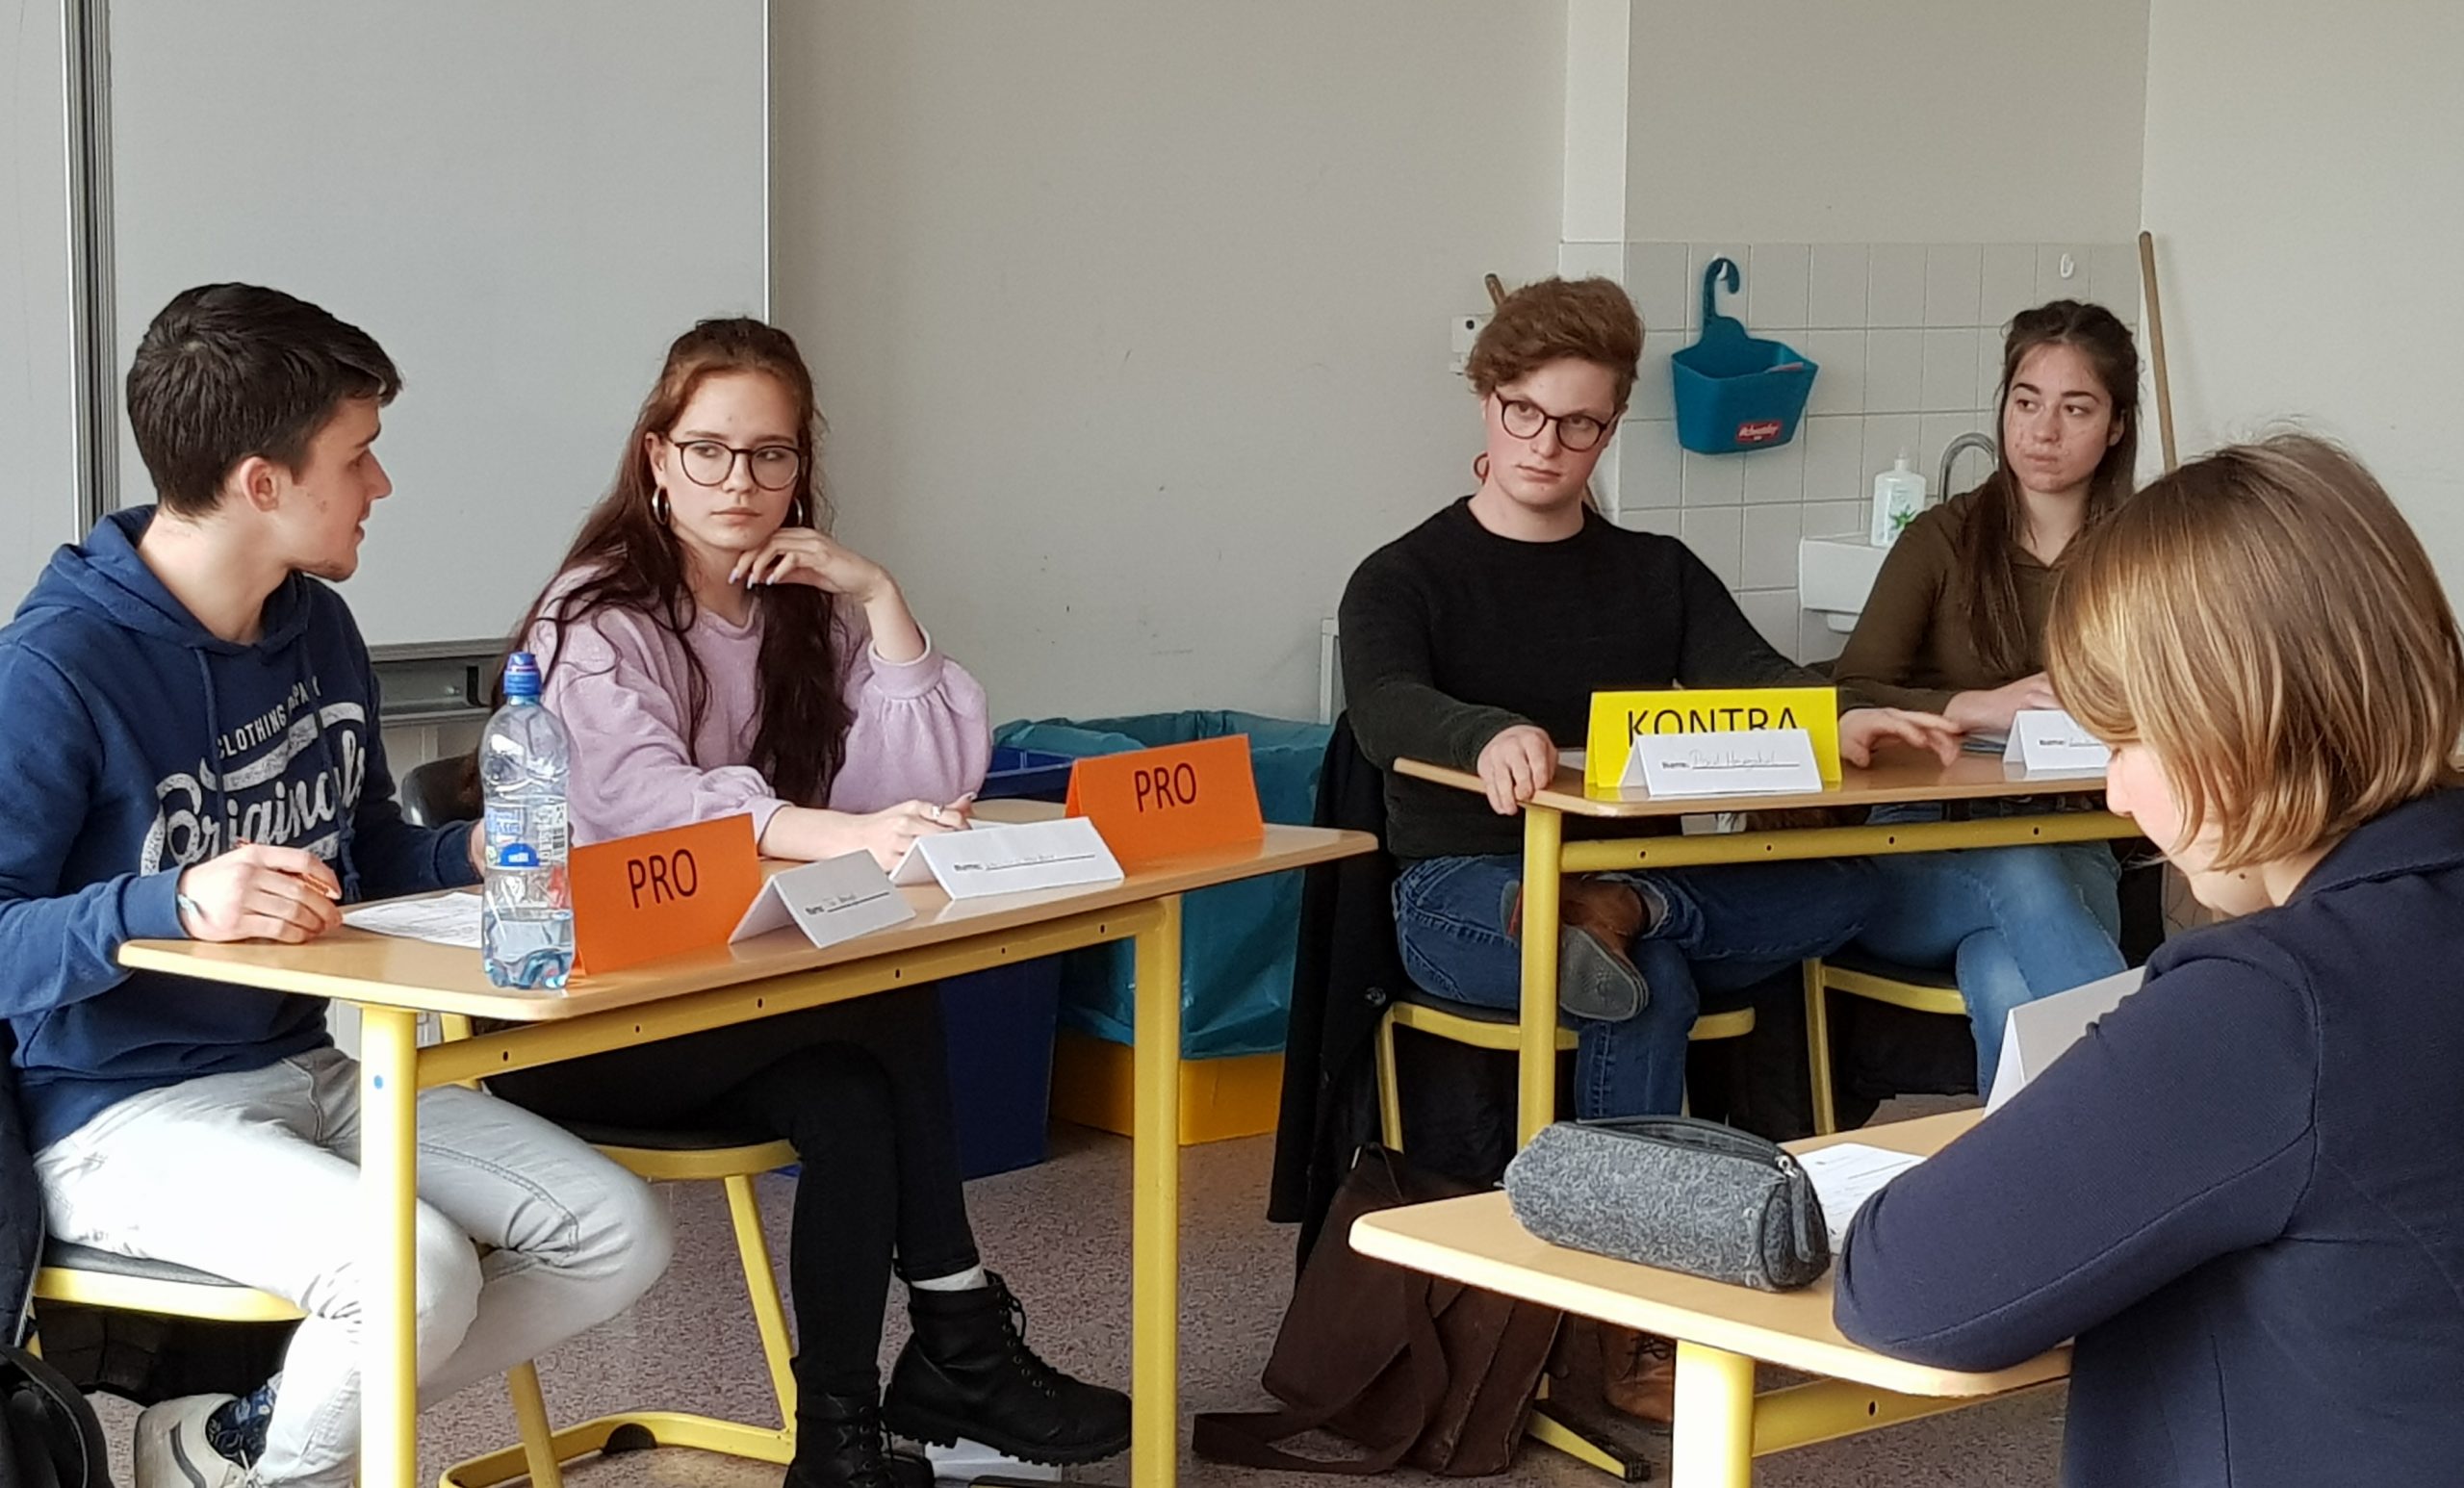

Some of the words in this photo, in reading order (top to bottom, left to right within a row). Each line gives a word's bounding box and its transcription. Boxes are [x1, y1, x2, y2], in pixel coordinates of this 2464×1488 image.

[1627, 706, 1798, 749] KONTRA
[1134, 761, 1197, 813] PRO
[627, 848, 698, 910] PRO
